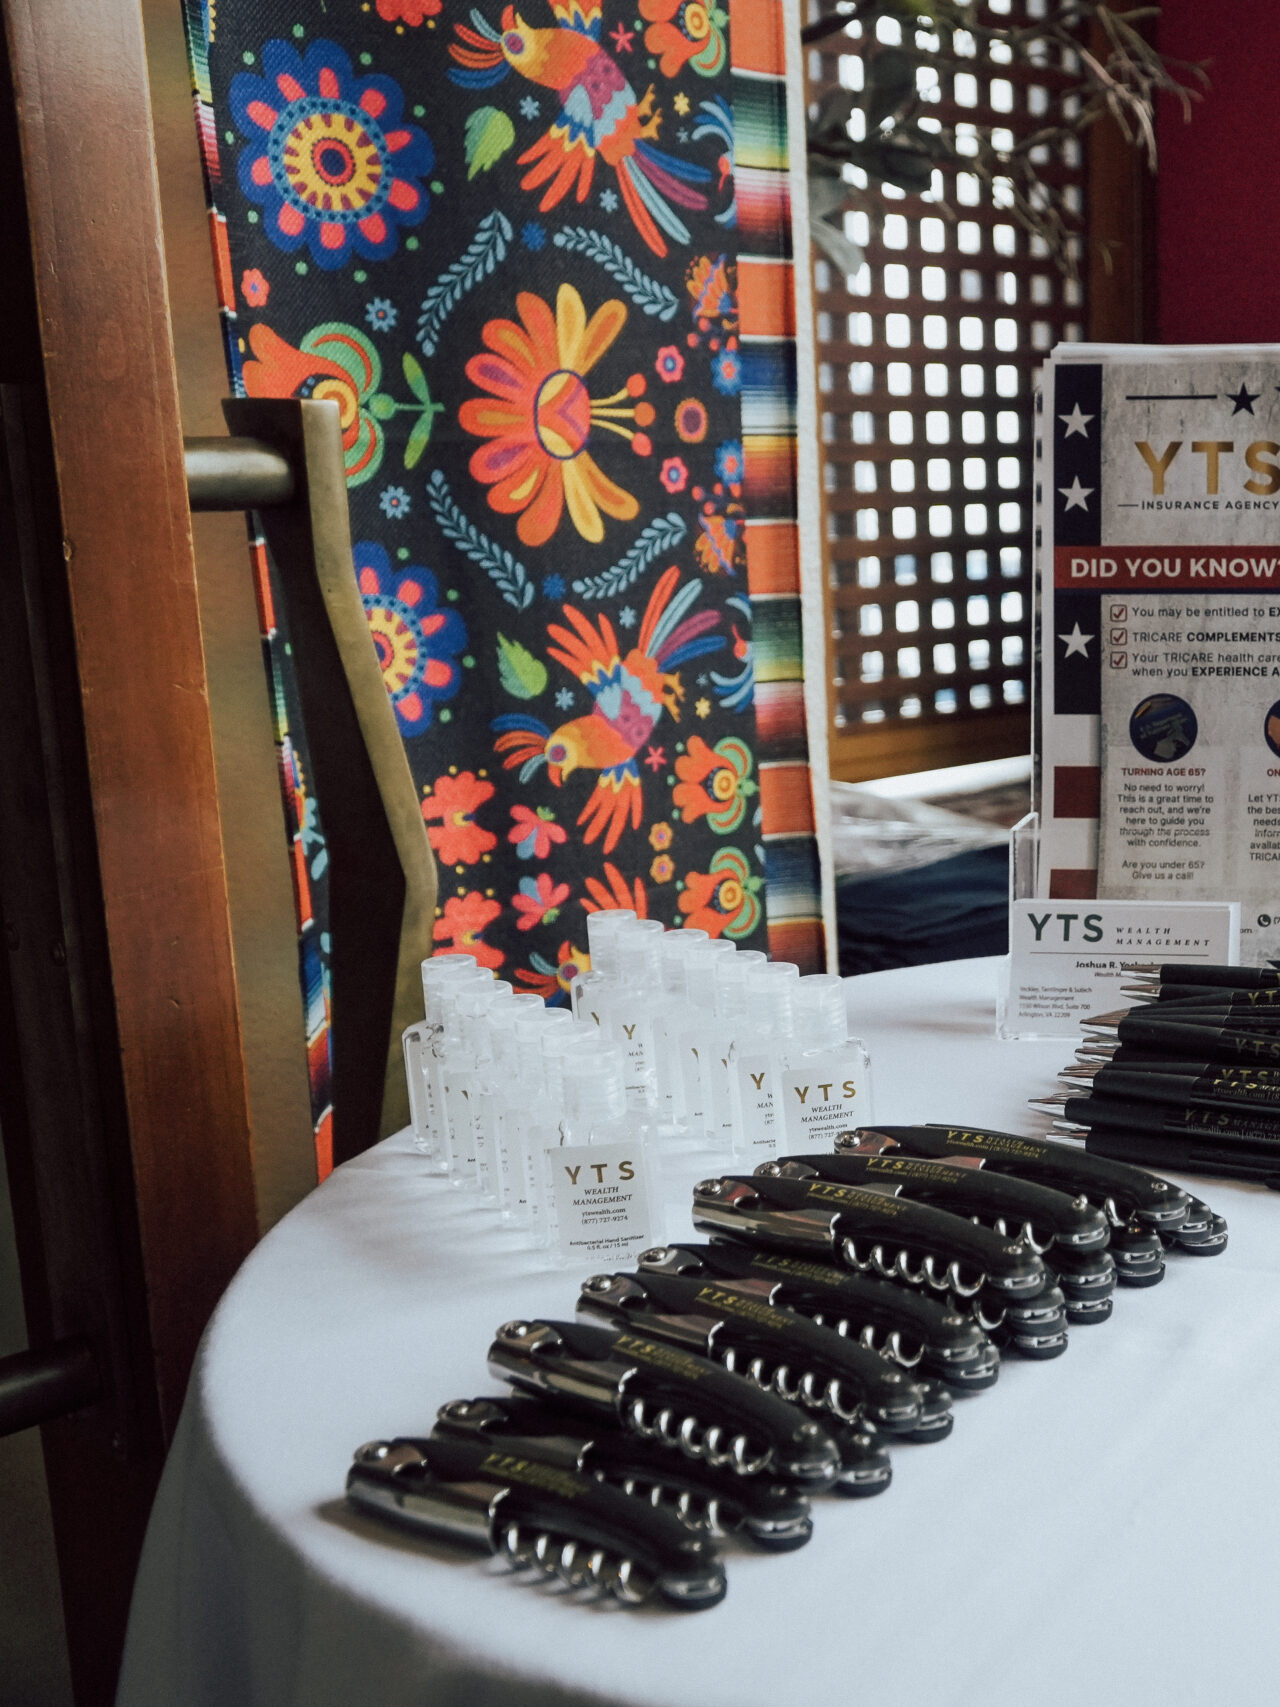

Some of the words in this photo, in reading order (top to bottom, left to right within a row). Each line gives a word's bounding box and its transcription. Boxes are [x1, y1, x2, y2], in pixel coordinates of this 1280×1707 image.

[1142, 501, 1219, 510] INSURANCE
[1226, 501, 1279, 510] AGENCY
[1071, 558, 1117, 578] DID
[1125, 558, 1181, 578] YOU
[1133, 607, 1154, 617] You
[1158, 608, 1182, 619] may
[1186, 607, 1200, 617] be
[1204, 607, 1248, 617] entitled
[1254, 608, 1264, 617] to
[1134, 632, 1182, 642] TRICARE
[1133, 653, 1159, 663] Your
[1163, 653, 1213, 662] TRICARE
[1218, 652, 1253, 662] health
[1133, 667, 1162, 676] when
[1168, 669, 1188, 678] you
[1192, 667, 1267, 676] EXPERIENCE
[1272, 667, 1280, 676] A
[1122, 768, 1163, 776] TURNING
[1166, 768, 1186, 776] AGE
[1188, 768, 1206, 776] 65?
[1267, 769, 1280, 777] ON
[1124, 783, 1137, 792] No
[1140, 783, 1161, 792] need
[1165, 784, 1173, 792] to
[1176, 784, 1205, 793] worry!
[1118, 794, 1136, 803] This
[1139, 794, 1145, 803] is
[1156, 795, 1180, 804] great
[1183, 794, 1202, 803] time
[1205, 795, 1214, 803] to
[1248, 794, 1263, 803] Let
[1120, 806, 1145, 814] reach
[1148, 806, 1165, 814] out,
[1167, 806, 1184, 814] and
[1187, 806, 1211, 814] we're
[1248, 806, 1262, 814] the
[1126, 817, 1146, 825] here
[1149, 817, 1158, 825] to
[1160, 817, 1185, 826] guide
[1188, 818, 1205, 826] you
[1120, 827, 1154, 837] through
[1174, 829, 1210, 837] process
[1149, 839, 1200, 847] confidence.
[1122, 860, 1137, 868] Are
[1140, 862, 1157, 870] you
[1160, 860, 1185, 868] under
[1028, 913, 1103, 942] YTS
[1116, 938, 1210, 947] MANAGEMENT
[1076, 961, 1107, 969] Joshua
[1109, 961, 1118, 969] R.
[1235, 1038, 1280, 1058] YTS
[1222, 1068, 1268, 1082] YTS
[794, 1080, 856, 1104] YTS
[811, 1104, 842, 1113] WEALTH
[801, 1111, 854, 1123] MANAGEMENT
[1185, 1109, 1230, 1125] YTS
[809, 1123, 848, 1133] ytswealth.com
[947, 1131, 984, 1143] YTS
[867, 1158, 904, 1169] YTS
[565, 1161, 635, 1185] YTS
[584, 1187, 619, 1195] WEALTH
[810, 1183, 846, 1197] YTS
[573, 1194, 632, 1206] MANAGEMENT
[582, 1208, 626, 1217] ytswealth.com
[570, 1238, 603, 1246] Antibacterial
[699, 1287, 738, 1304] YTS
